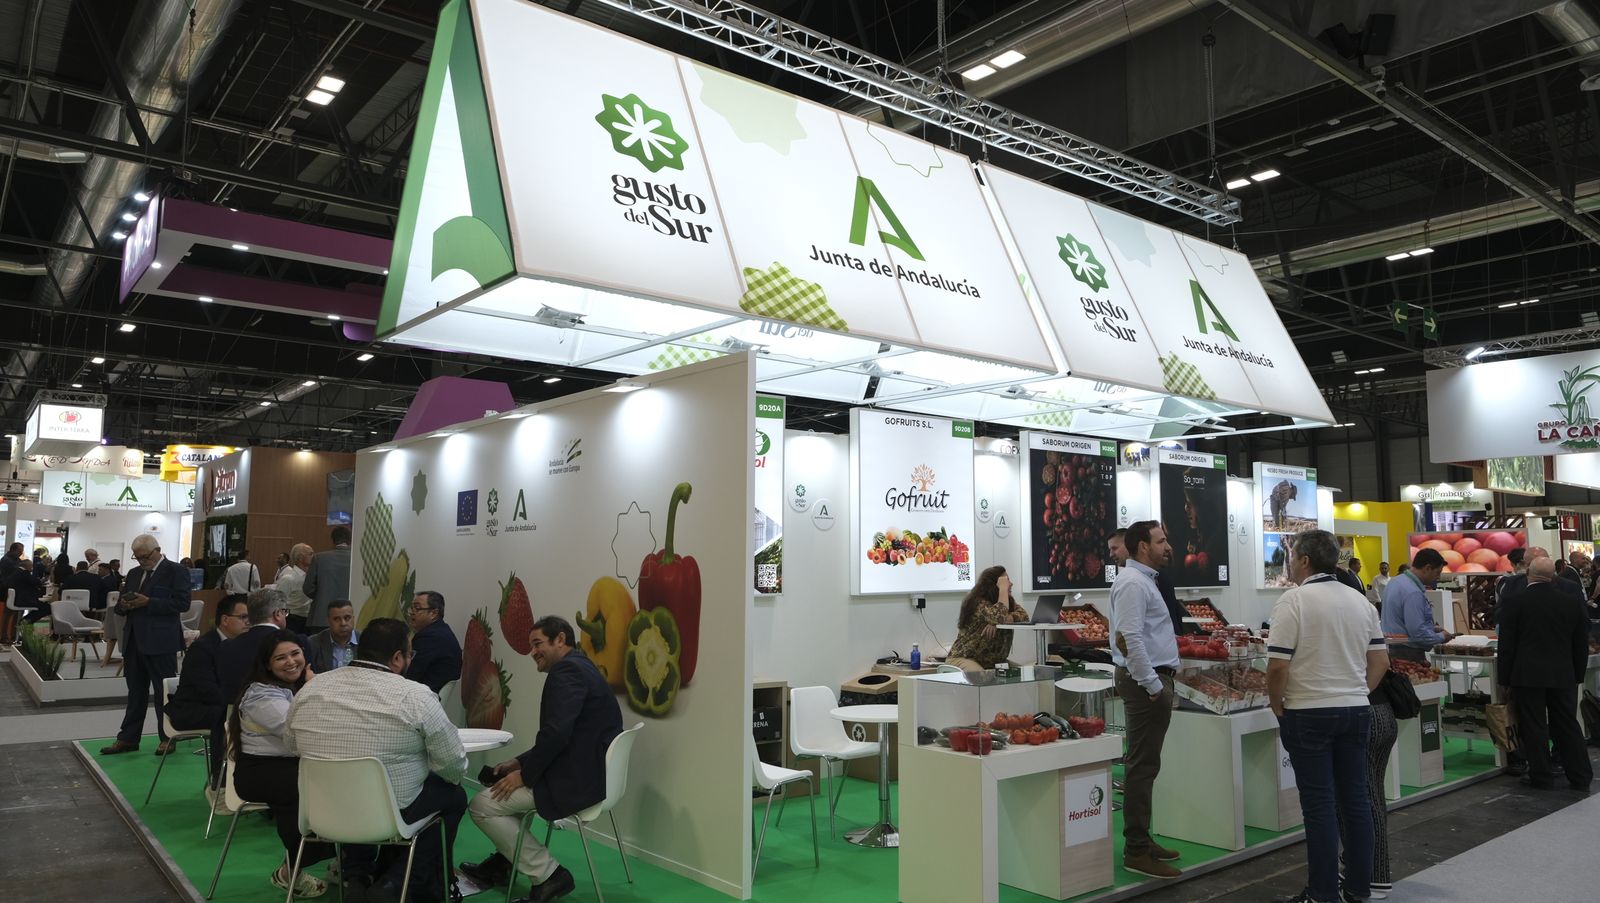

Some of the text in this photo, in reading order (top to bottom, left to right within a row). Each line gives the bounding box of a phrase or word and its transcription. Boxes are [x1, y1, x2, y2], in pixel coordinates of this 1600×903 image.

[611, 174, 706, 215] gusto
[624, 204, 712, 244] del Sur
[809, 245, 981, 299] Junta de Andalucía
[1080, 296, 1129, 322] gusto
[1093, 317, 1137, 343] del Sur
[1182, 335, 1274, 369] Junta de Andalucía
[758, 403, 782, 412] 9D20A
[885, 417, 934, 429] GOFRUITS S.L.
[1537, 420, 1567, 428] GRUPO
[1042, 438, 1092, 450] SABORUM ORIGEN
[1538, 428, 1562, 441] LA
[1169, 453, 1207, 463] SABORUM ORIGEN
[886, 486, 950, 512] Gofruit
[1069, 806, 1101, 821] Hortisol
